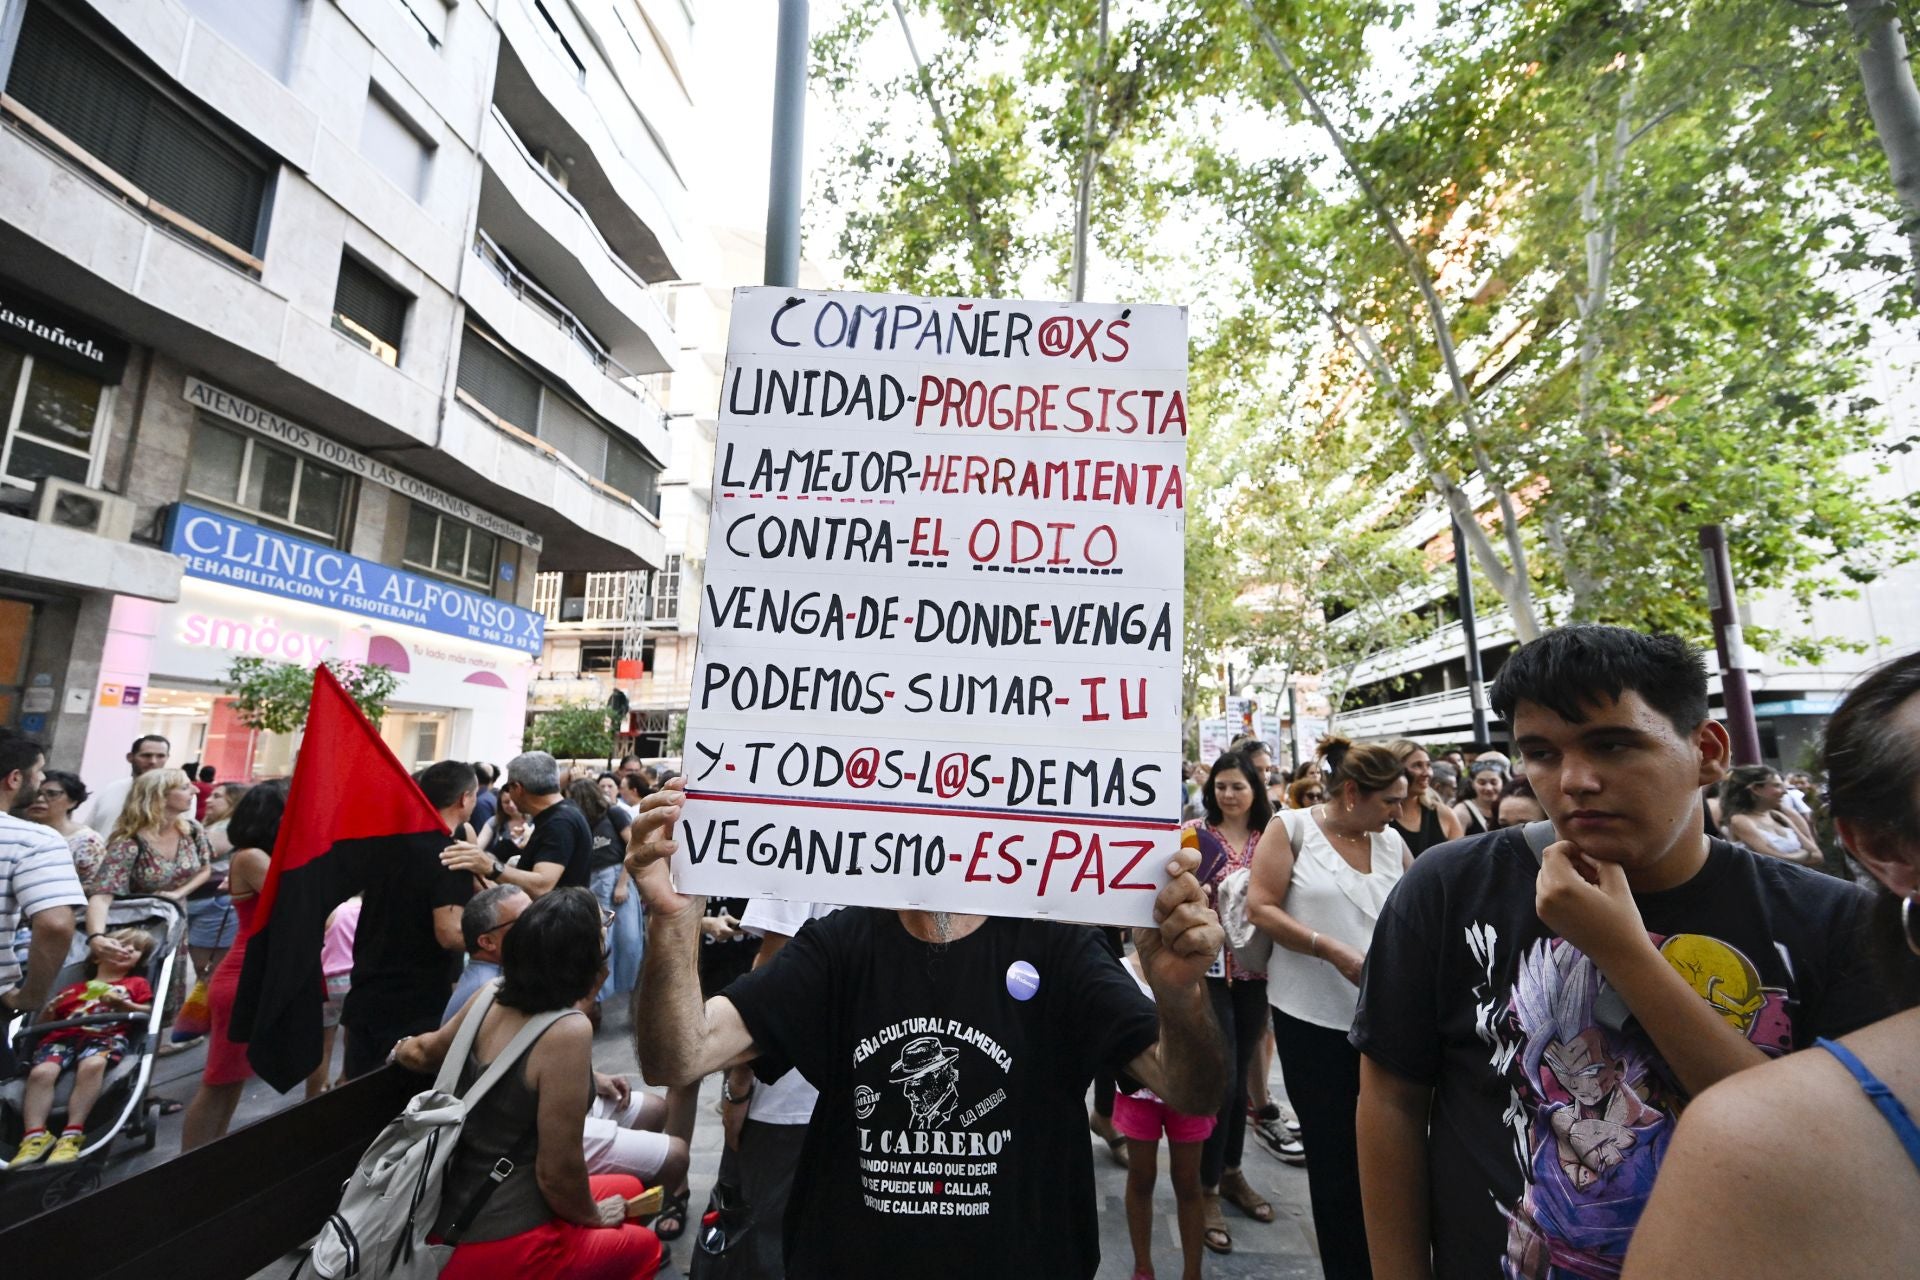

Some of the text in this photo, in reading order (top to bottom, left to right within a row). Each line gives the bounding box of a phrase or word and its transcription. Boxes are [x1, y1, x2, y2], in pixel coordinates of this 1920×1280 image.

[0, 301, 104, 362] astañeda
[190, 384, 309, 448] ATENDEMOS
[315, 437, 366, 473] TODAS
[371, 463, 396, 485] LAS
[968, 519, 1118, 567] ODIO
[180, 553, 427, 624] REHABILITACION Y FISIOTERAPIA
[184, 517, 542, 639] CLINICA ALFONSO X
[183, 613, 330, 670] smöoy
[503, 633, 514, 645] 23
[879, 1017, 945, 1045] CULTURAL
[946, 1019, 1013, 1074] FLAMENCA
[959, 1088, 1007, 1127] LA HABA
[868, 1179, 879, 1191] SE
[880, 1180, 917, 1194] PUEDE
[944, 1182, 992, 1197] CALLAR,
[890, 1161, 912, 1175] HAY
[913, 1162, 943, 1175] ALGO
[944, 1163, 965, 1177] QUE
[967, 1162, 998, 1176] DECIR
[892, 1200, 938, 1215] CALLAR
[939, 1201, 955, 1215] ES
[955, 1202, 990, 1216] MORIR
